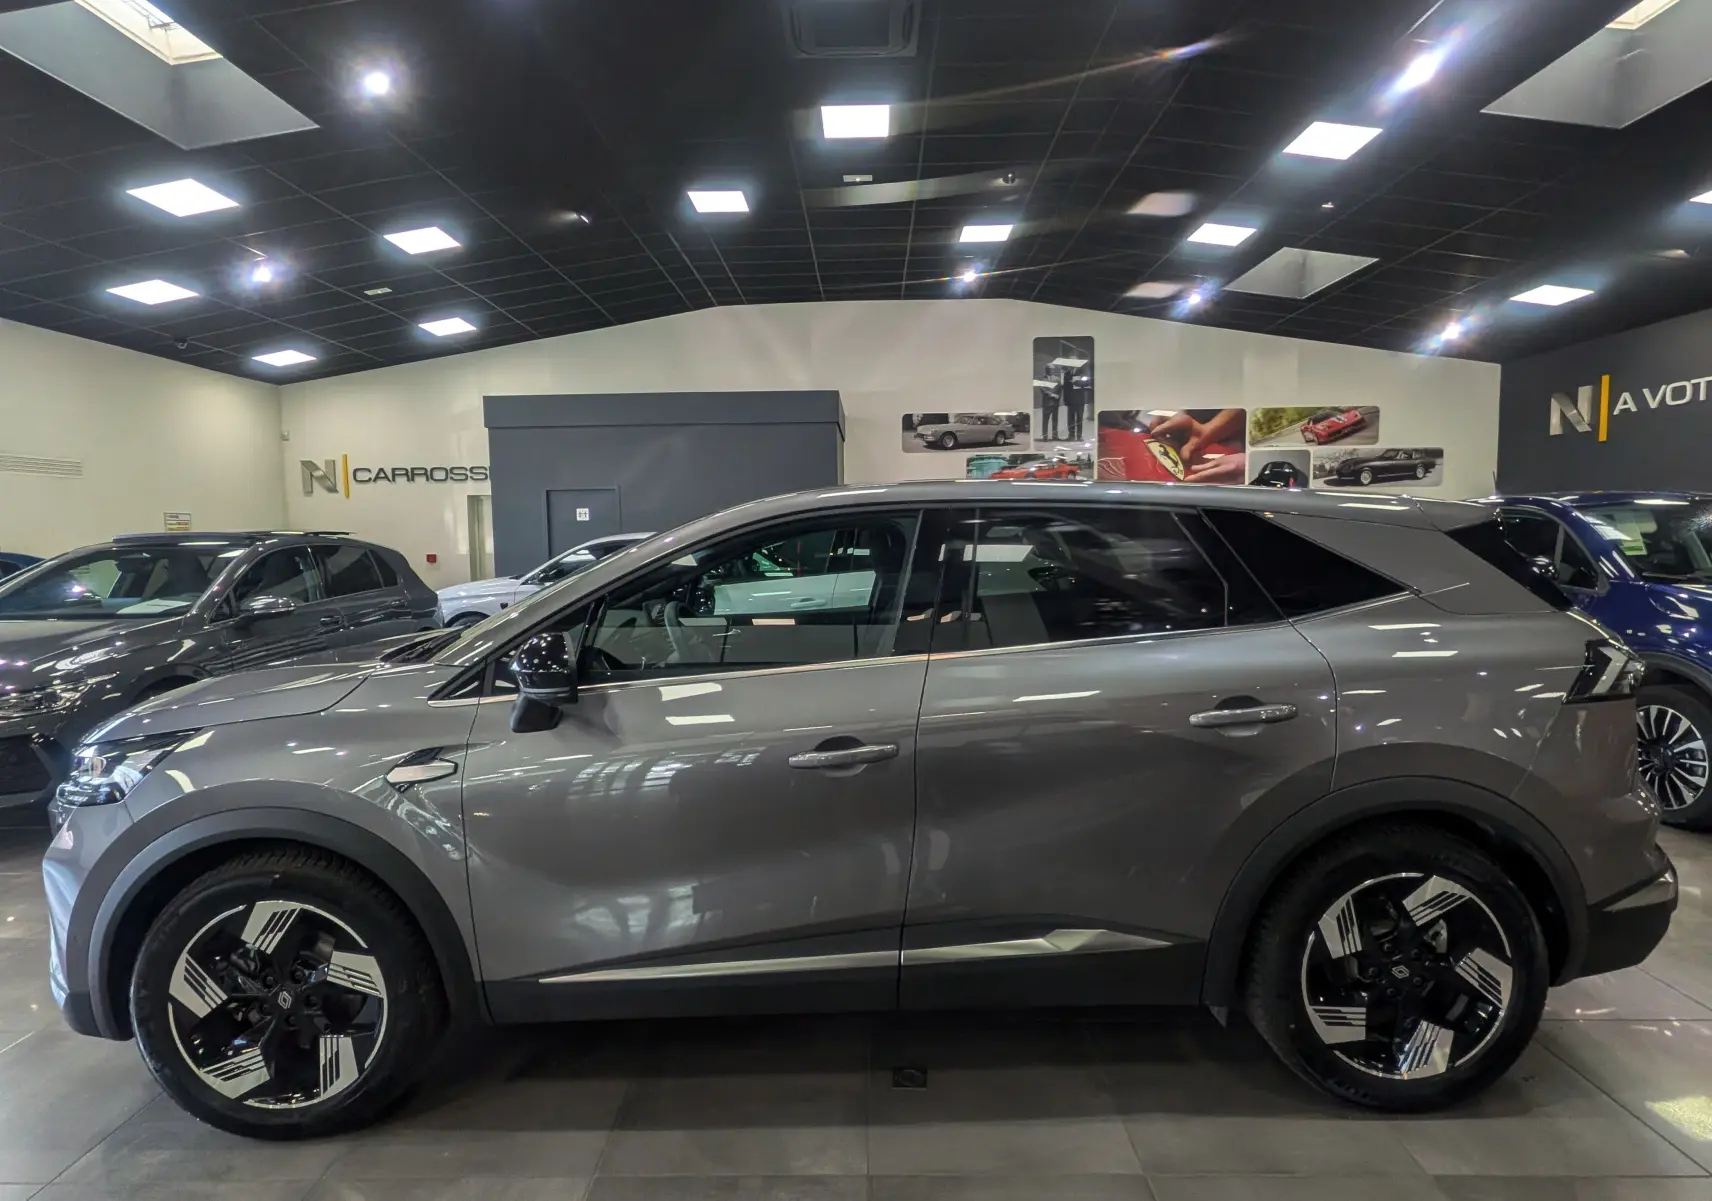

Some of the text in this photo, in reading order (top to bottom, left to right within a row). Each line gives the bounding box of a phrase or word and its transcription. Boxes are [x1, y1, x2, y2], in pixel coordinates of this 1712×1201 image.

[1550, 376, 1712, 436] N A VOT
[300, 459, 490, 495] N CARROSS
